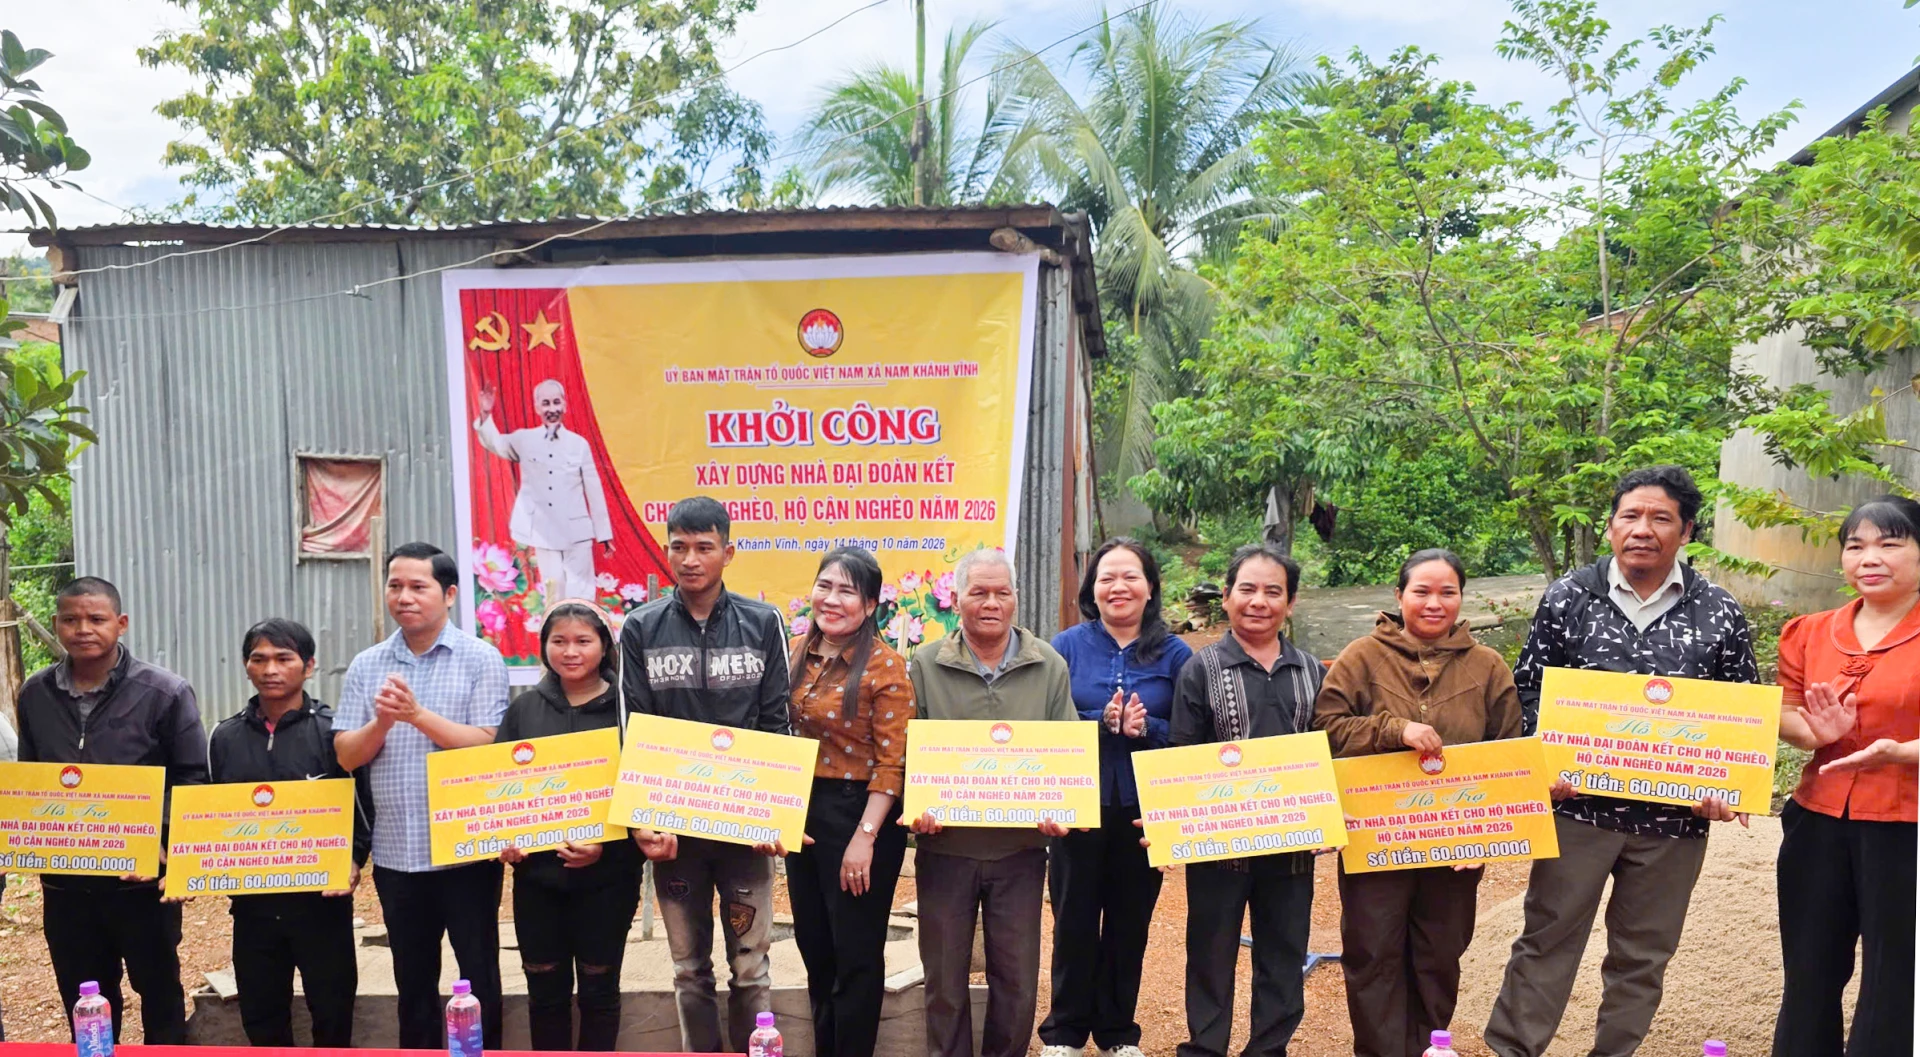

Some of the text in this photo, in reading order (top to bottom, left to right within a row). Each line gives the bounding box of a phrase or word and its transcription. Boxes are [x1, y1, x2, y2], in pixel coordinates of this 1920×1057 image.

[682, 370, 704, 382] BAN
[708, 368, 730, 384] MẶT
[734, 367, 762, 384] TRẬN
[781, 364, 810, 381] QUỐC
[813, 364, 835, 383] VIỆT
[839, 366, 863, 379] NAM
[867, 364, 881, 378] XÃ
[885, 365, 909, 378] NAM
[914, 361, 950, 377] KHÁNH
[707, 400, 938, 444] KHỞI CÔNG
[696, 456, 954, 490] XÂY DỰNG NHÀ ĐẠI ĐOÀN KẾT
[644, 495, 996, 524] CH GHÈO, HỘ CẬN NGHÈO NĂM 2026
[737, 538, 771, 550] Khánh
[775, 538, 801, 550] Vĩnh,
[805, 538, 830, 551] ngày
[834, 538, 845, 548] 14
[849, 537, 878, 551] tháng
[883, 538, 893, 549] 10
[897, 538, 918, 549] năm
[922, 538, 945, 550] 2026
[646, 654, 694, 678] NOX
[1542, 731, 1564, 744] XÂY
[1567, 734, 1591, 746] NHÀ
[1594, 738, 1613, 751] ĐẠI
[1617, 740, 1649, 753] ĐOÀN
[1652, 741, 1674, 755] KẾT
[1678, 747, 1702, 758] CHO
[1705, 748, 1722, 763] HỘ
[1577, 752, 1728, 778] HỘ CẬN NGHÈO NĂM 2026
[1586, 773, 1625, 792] tiền:
[434, 787, 613, 822] XÂY NHÀ ĐẠI ĐOÀN KẾT CHO HỘ NGHÈ
[649, 792, 663, 804] HỘ
[665, 794, 686, 807] CẬN
[722, 802, 746, 814] NĂM
[747, 807, 772, 818] 2026
[940, 789, 953, 801] HỘ
[956, 789, 975, 801] CẬN
[1014, 790, 1036, 800] NĂM
[1040, 792, 1063, 800] 2026
[467, 821, 480, 834] HỘ
[483, 819, 503, 832] CẬN
[541, 810, 564, 822] NĂM
[567, 807, 590, 818] 2026
[950, 806, 982, 821] tiền:
[1148, 810, 1167, 822] XÂY
[1169, 807, 1190, 820] NHÀ
[1191, 807, 1208, 818] ĐẠI
[1210, 802, 1238, 815] ĐOÀN
[1240, 798, 1259, 812] KẾT
[1260, 799, 1281, 809] CHO
[1283, 795, 1297, 808] HỘ
[1364, 816, 1386, 828] NHÀ
[1388, 816, 1406, 827] ĐẠI
[1409, 811, 1438, 824] ĐOÀN
[1441, 808, 1461, 821] KẾT
[1463, 808, 1486, 819] CHO
[1488, 804, 1504, 818] HỘ
[632, 808, 781, 843] Số tiền: 60.000.000đ
[1181, 822, 1196, 835] HỘ
[1197, 820, 1218, 834] CẬN
[1256, 814, 1280, 826] NĂM
[1282, 812, 1307, 823] 2026
[1377, 822, 1513, 844] HỘ CẬN NGHÈO NĂM 2026
[9, 835, 21, 847] HỘ
[24, 835, 43, 848] CẬN
[79, 837, 100, 848] NĂM
[103, 840, 126, 848] 2026
[1172, 830, 1324, 858] Số tiền: 60.000.000đ
[1367, 840, 1531, 867] Số tiền: 60.000.000đ
[17, 852, 48, 868] tiền:
[51, 856, 136, 871] 60.000.000đ
[296, 855, 319, 864] 2026
[188, 872, 330, 891] Số tiền: 60.000.000đ
